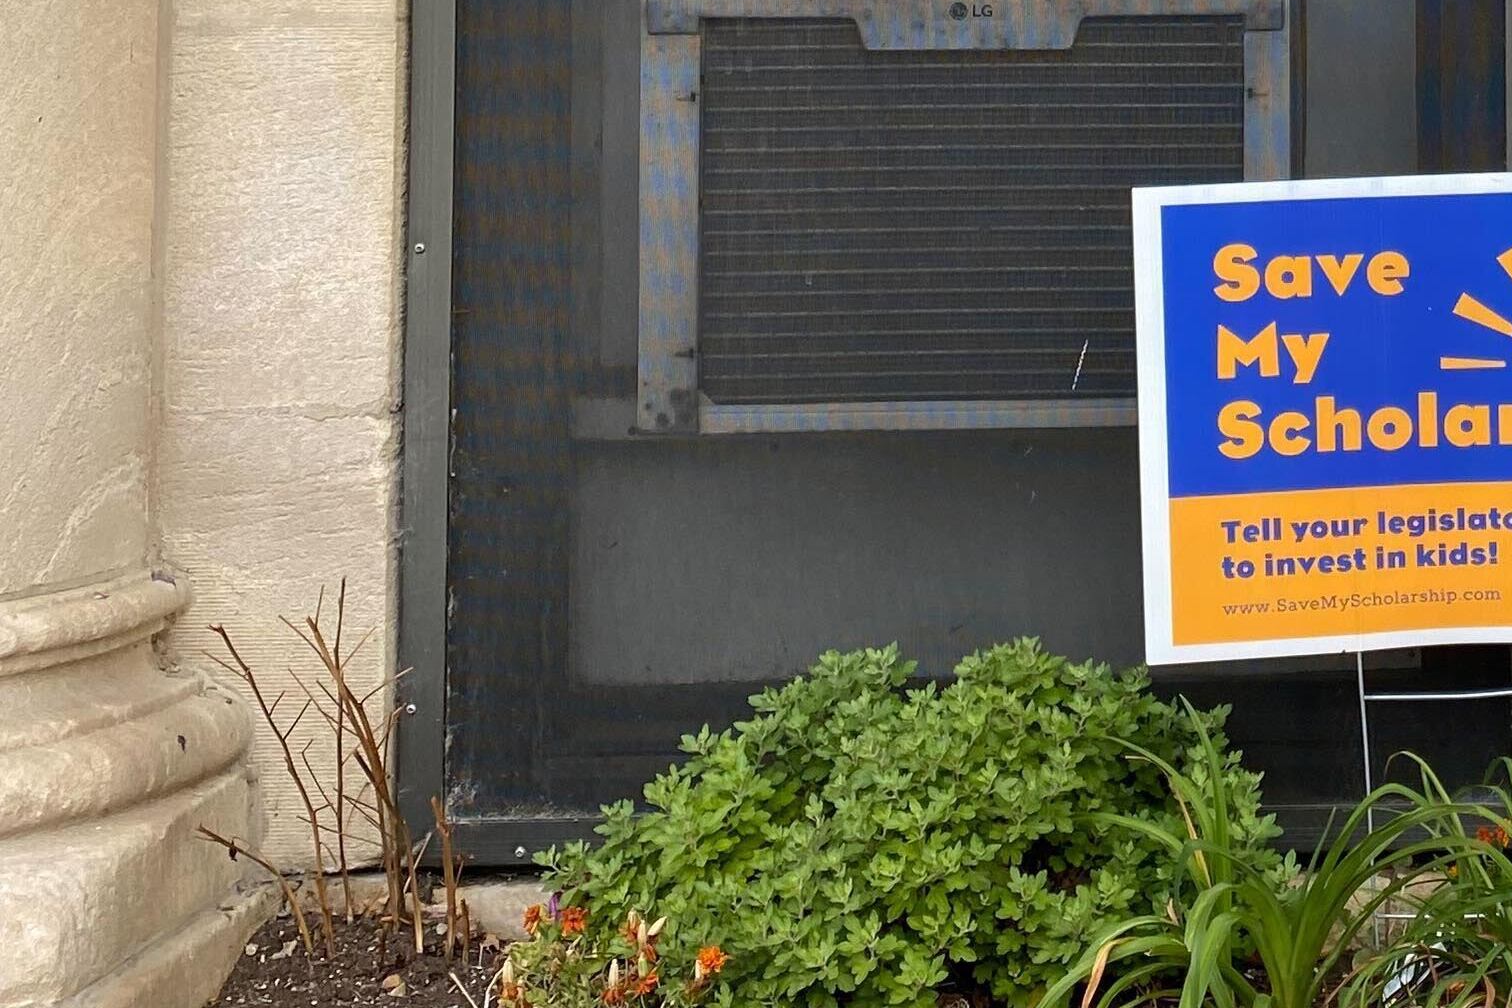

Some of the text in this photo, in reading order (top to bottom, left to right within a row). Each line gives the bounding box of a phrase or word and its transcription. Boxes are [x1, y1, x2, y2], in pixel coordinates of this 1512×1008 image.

[972, 4, 993, 17] LG
[1213, 244, 1411, 303] Save
[1217, 321, 1331, 384] My
[1221, 519, 1282, 544] Tell
[1291, 517, 1370, 544] your
[1222, 541, 1499, 580] to invest in kids!
[1222, 587, 1502, 617] www.SaveMyScholarship.com
